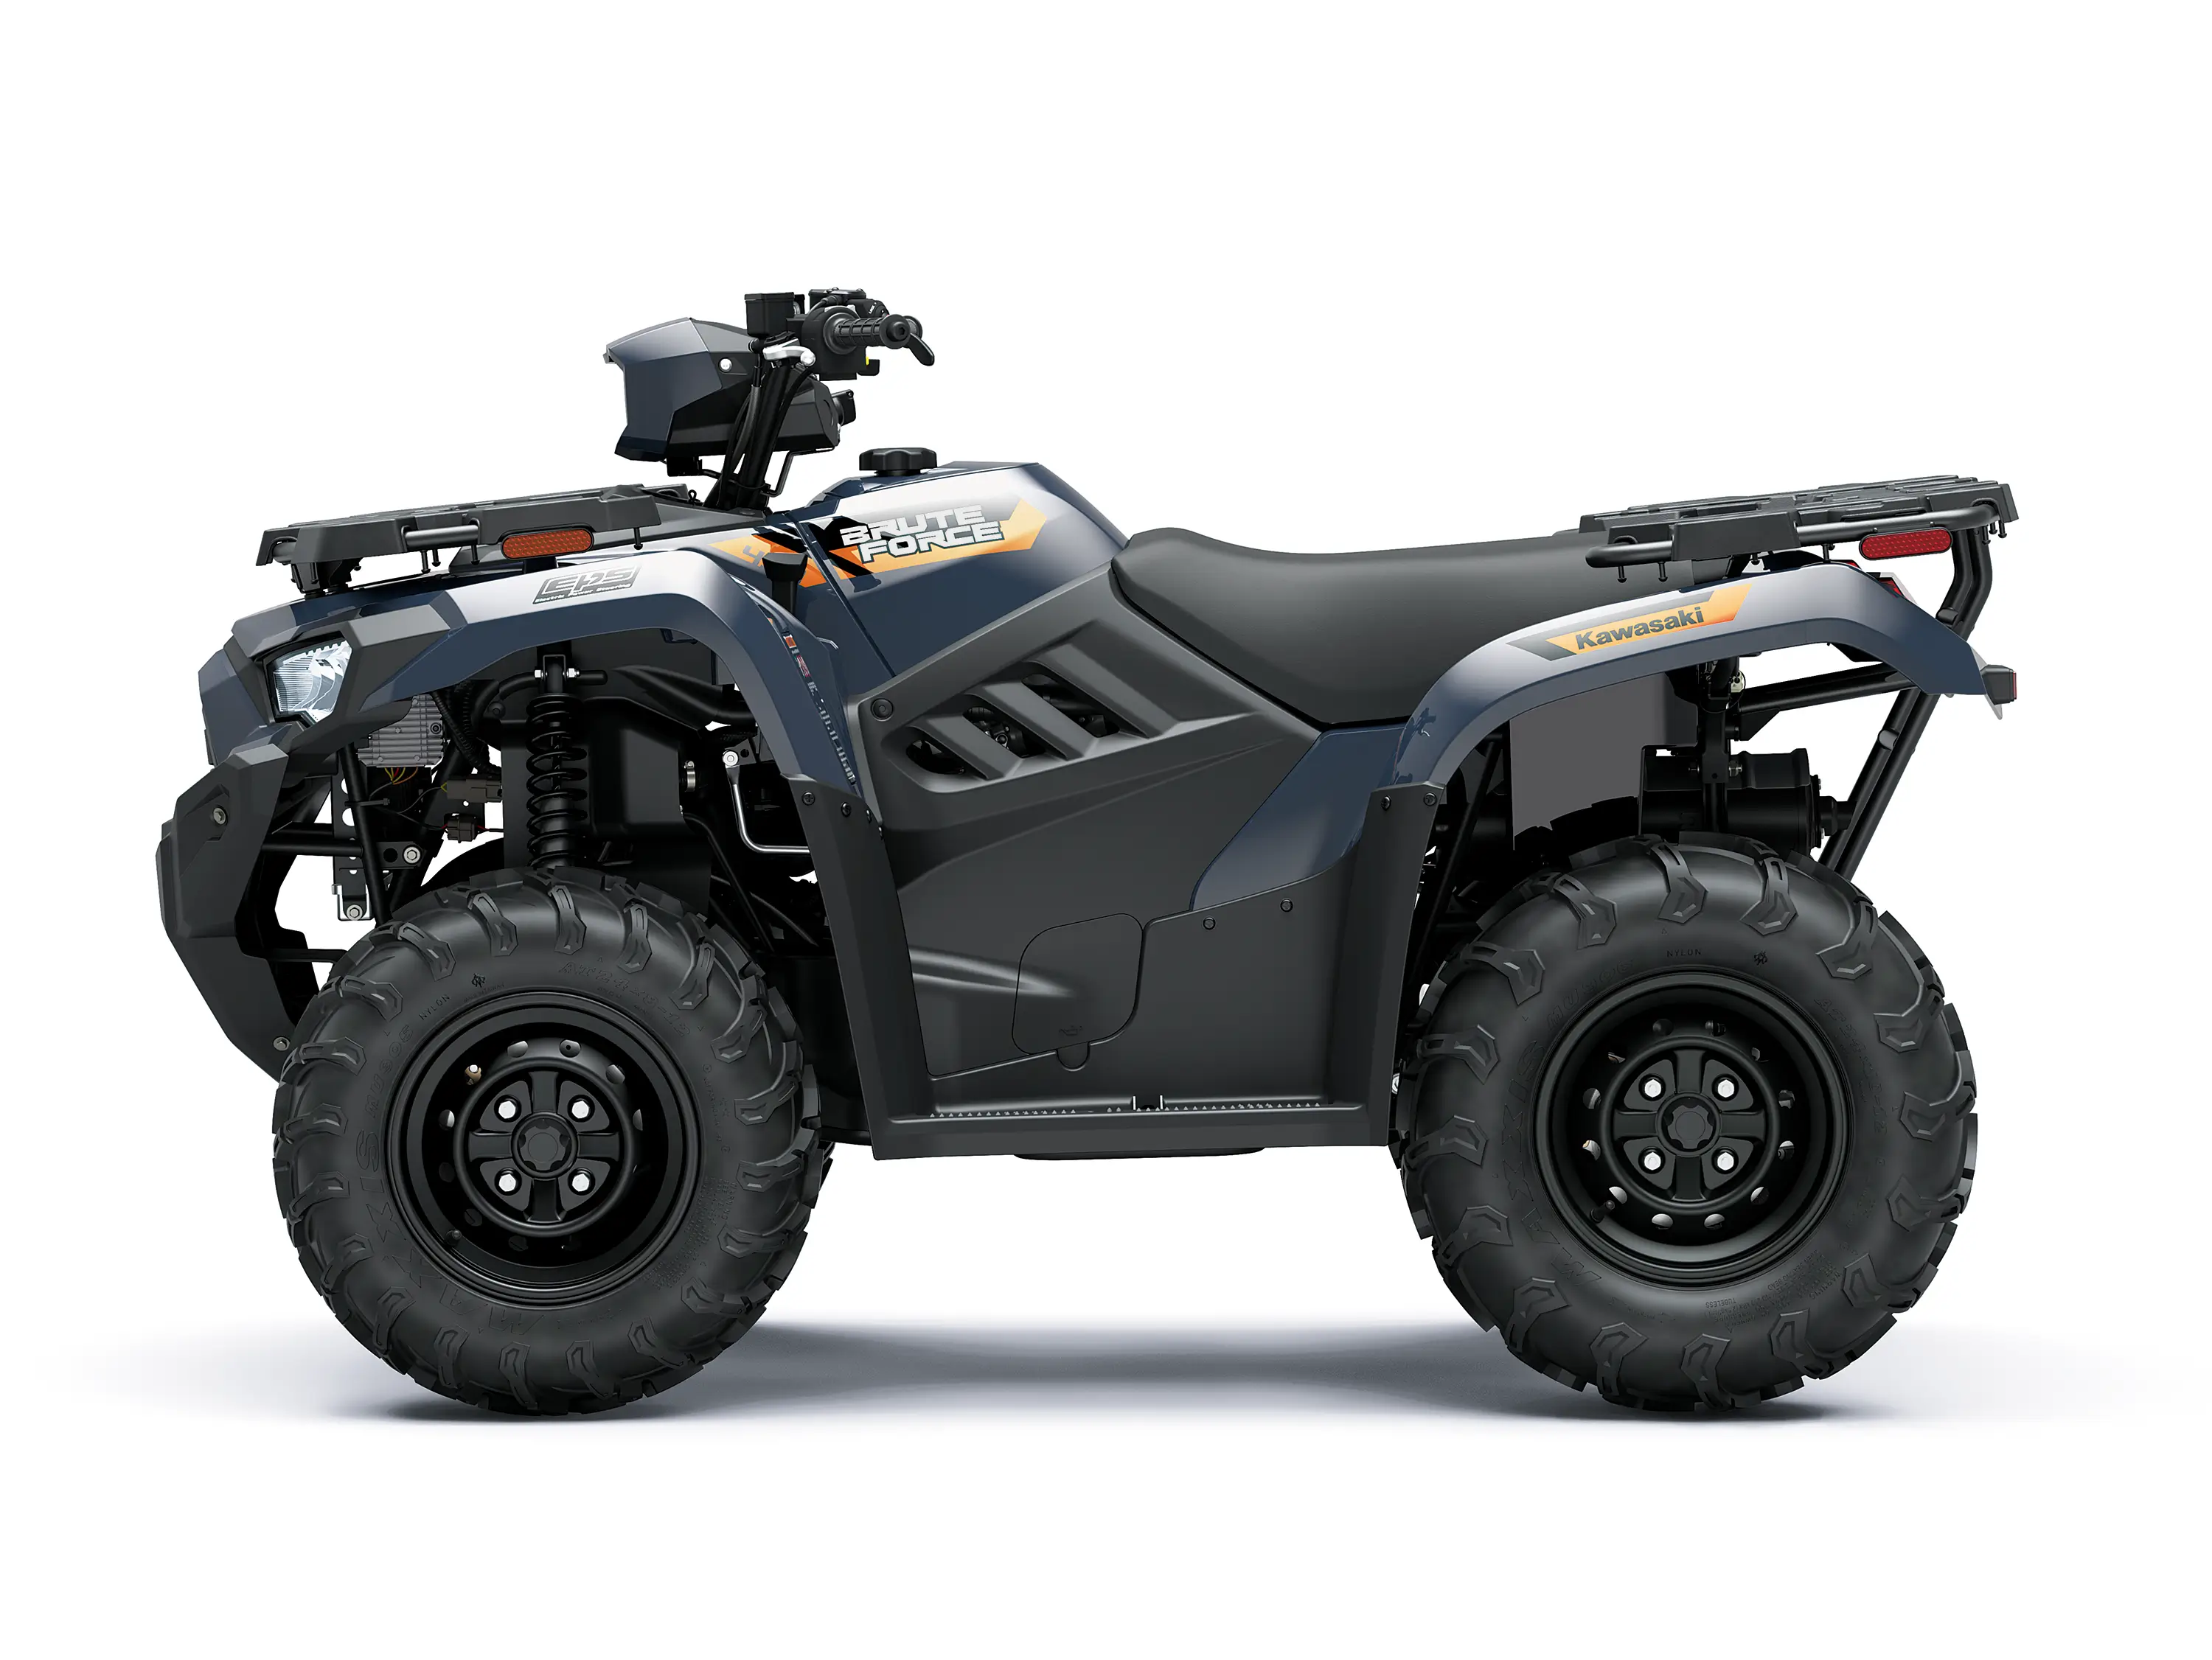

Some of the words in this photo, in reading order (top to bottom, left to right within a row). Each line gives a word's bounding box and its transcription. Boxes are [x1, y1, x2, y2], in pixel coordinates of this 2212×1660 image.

[839, 505, 986, 545] BRUTE
[858, 520, 1005, 564] FORCE
[542, 566, 639, 595] EPS
[1575, 606, 1705, 650] Kawasaki
[1666, 949, 1703, 958] NYLON
[418, 994, 451, 1021] NYLON
